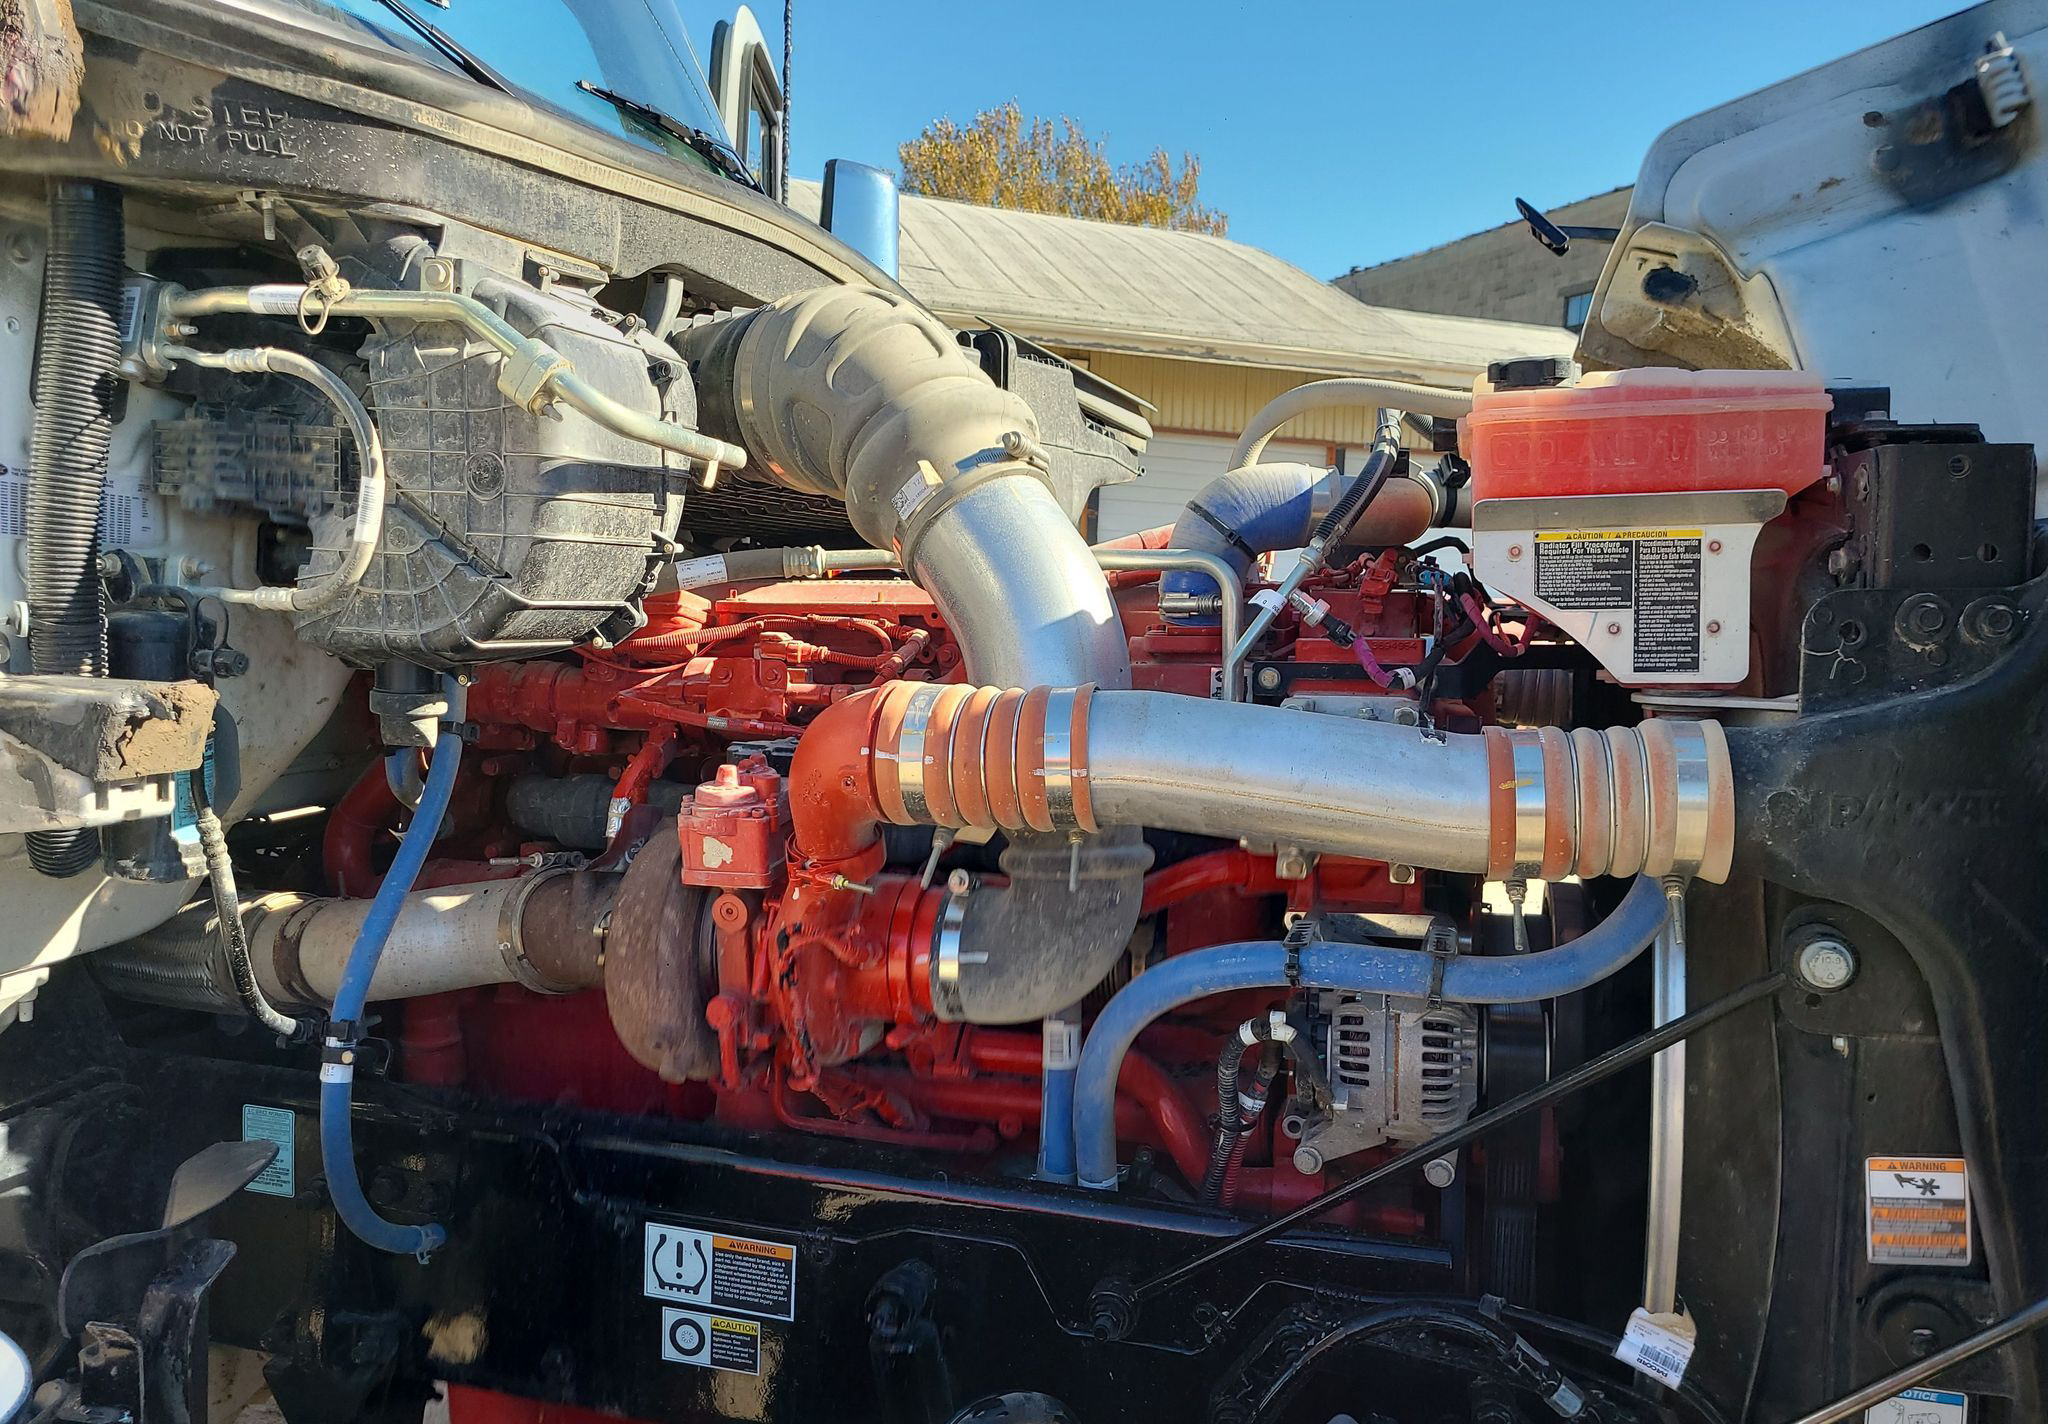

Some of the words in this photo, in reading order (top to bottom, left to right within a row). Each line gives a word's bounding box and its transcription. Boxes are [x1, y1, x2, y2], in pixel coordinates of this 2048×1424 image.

[157, 122, 208, 144] NOT
[226, 130, 298, 158] PULL
[1900, 1162, 1946, 1170] WARNING
[736, 1242, 776, 1255] WARNING
[731, 1283, 756, 1291] component
[720, 1321, 757, 1333] CAUTION
[1636, 1357, 1668, 1378] PACCAR
[1900, 1389, 1937, 1401] OTICE
